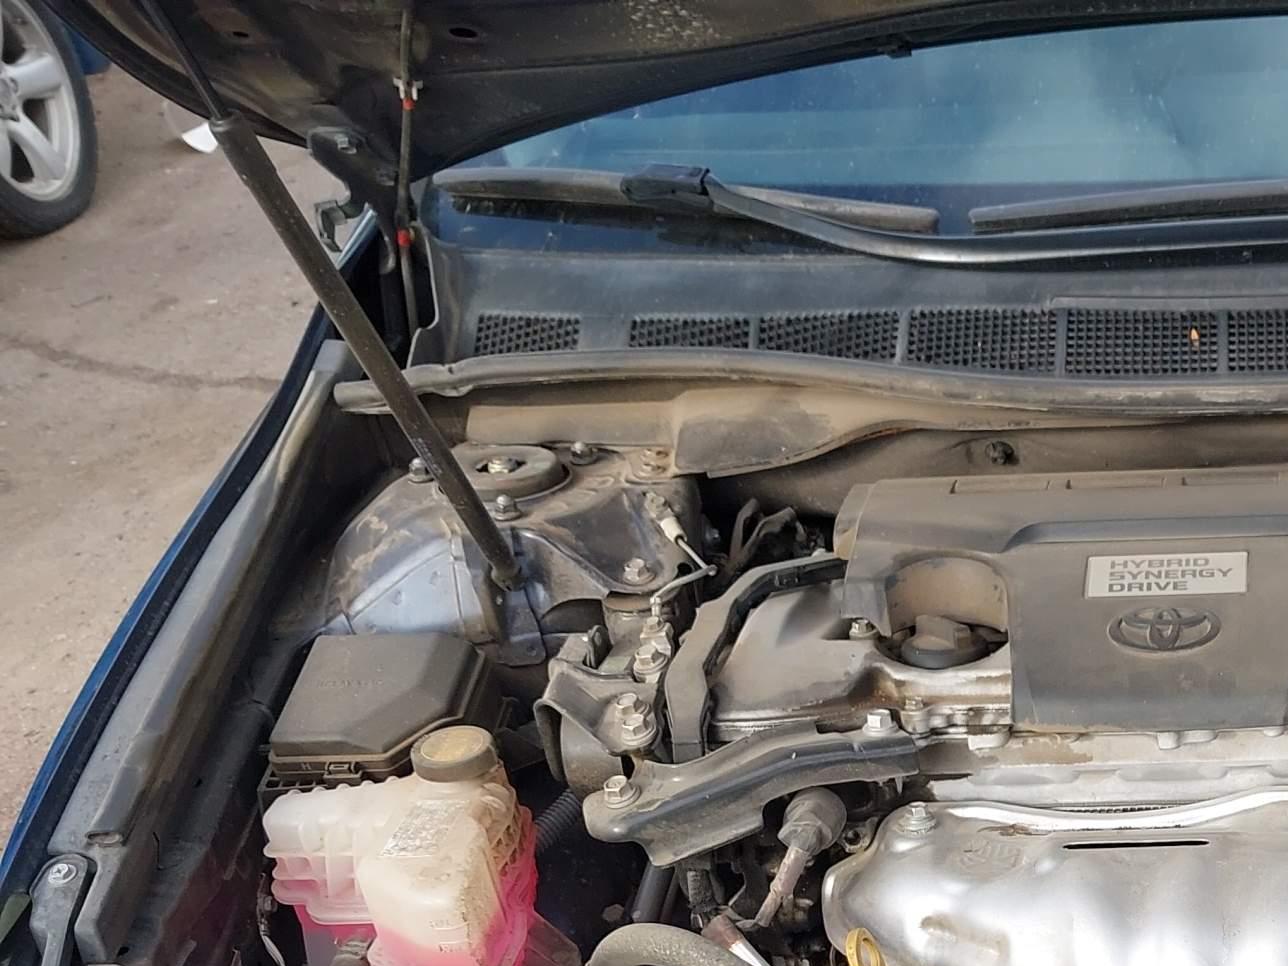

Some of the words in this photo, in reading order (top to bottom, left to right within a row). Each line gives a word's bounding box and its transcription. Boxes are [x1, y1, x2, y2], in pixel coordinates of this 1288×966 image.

[1110, 558, 1210, 569] HYBRID
[1109, 568, 1233, 582] SYNERGY
[1108, 580, 1189, 593] DRIVE
